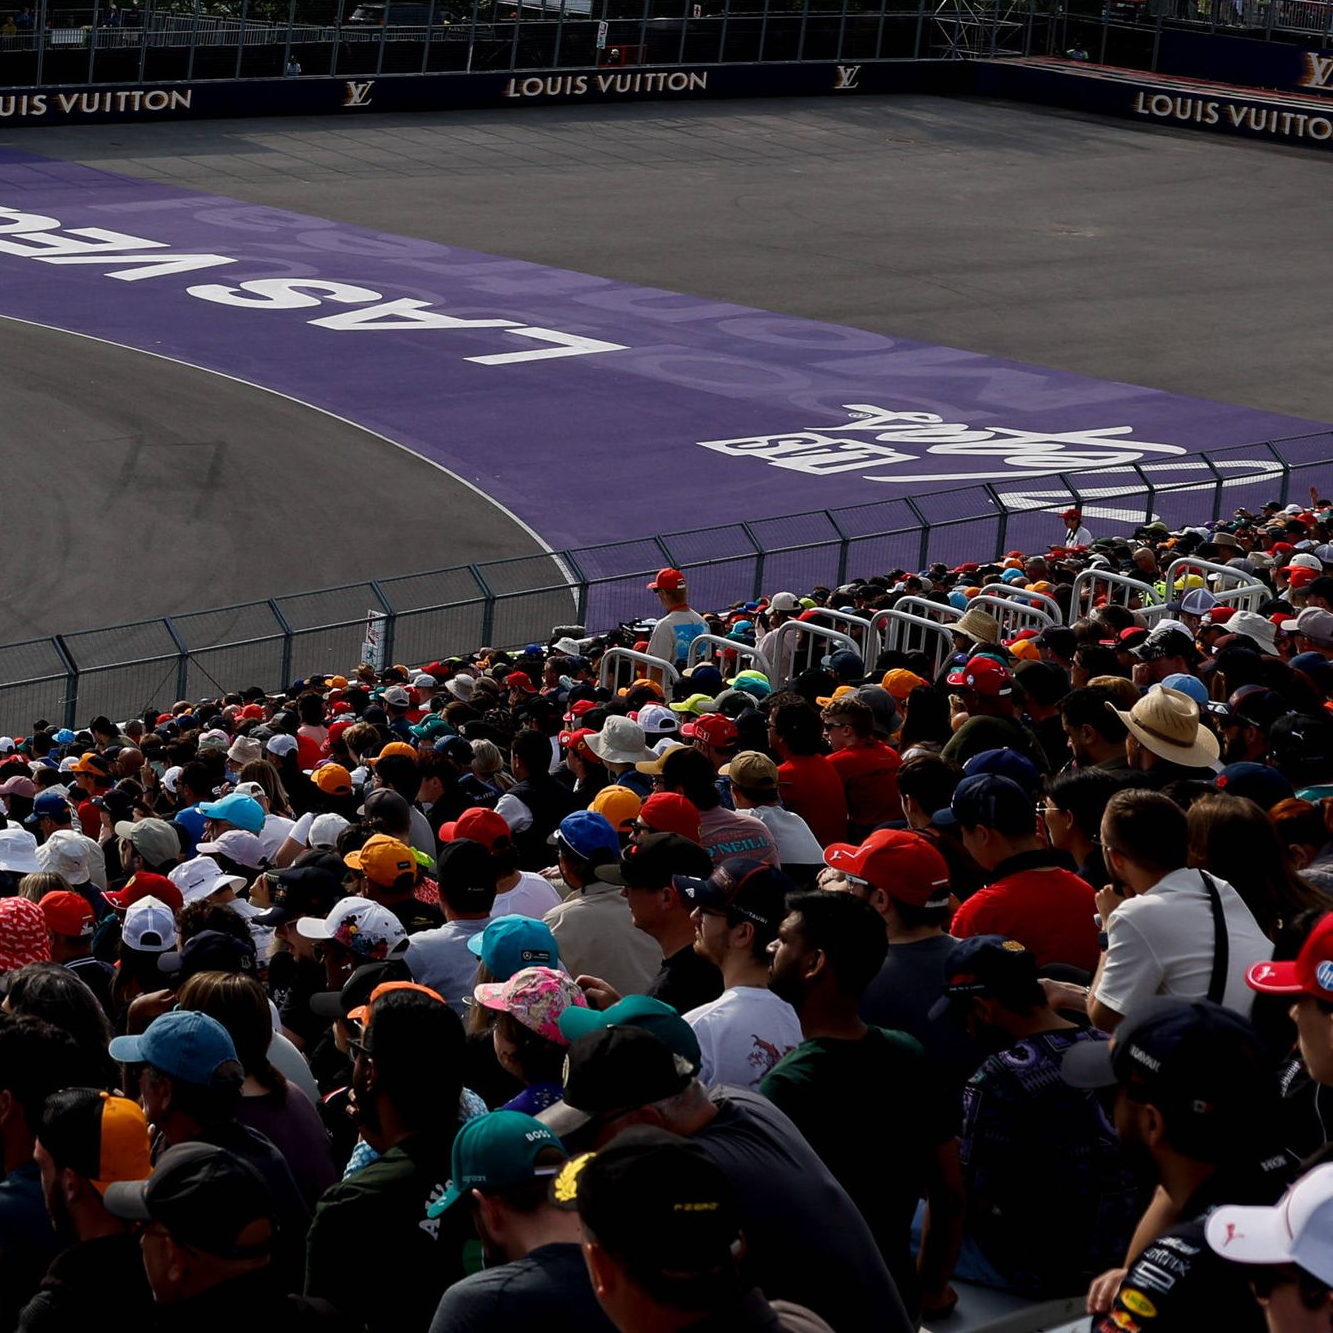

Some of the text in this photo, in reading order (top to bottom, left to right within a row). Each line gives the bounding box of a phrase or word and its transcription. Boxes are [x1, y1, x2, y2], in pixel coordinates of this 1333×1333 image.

[508, 71, 707, 98] LOUIS VUITTON
[59, 89, 192, 113] VUITTON
[1137, 92, 1220, 125] LOUIS
[185, 276, 632, 365] LAS
